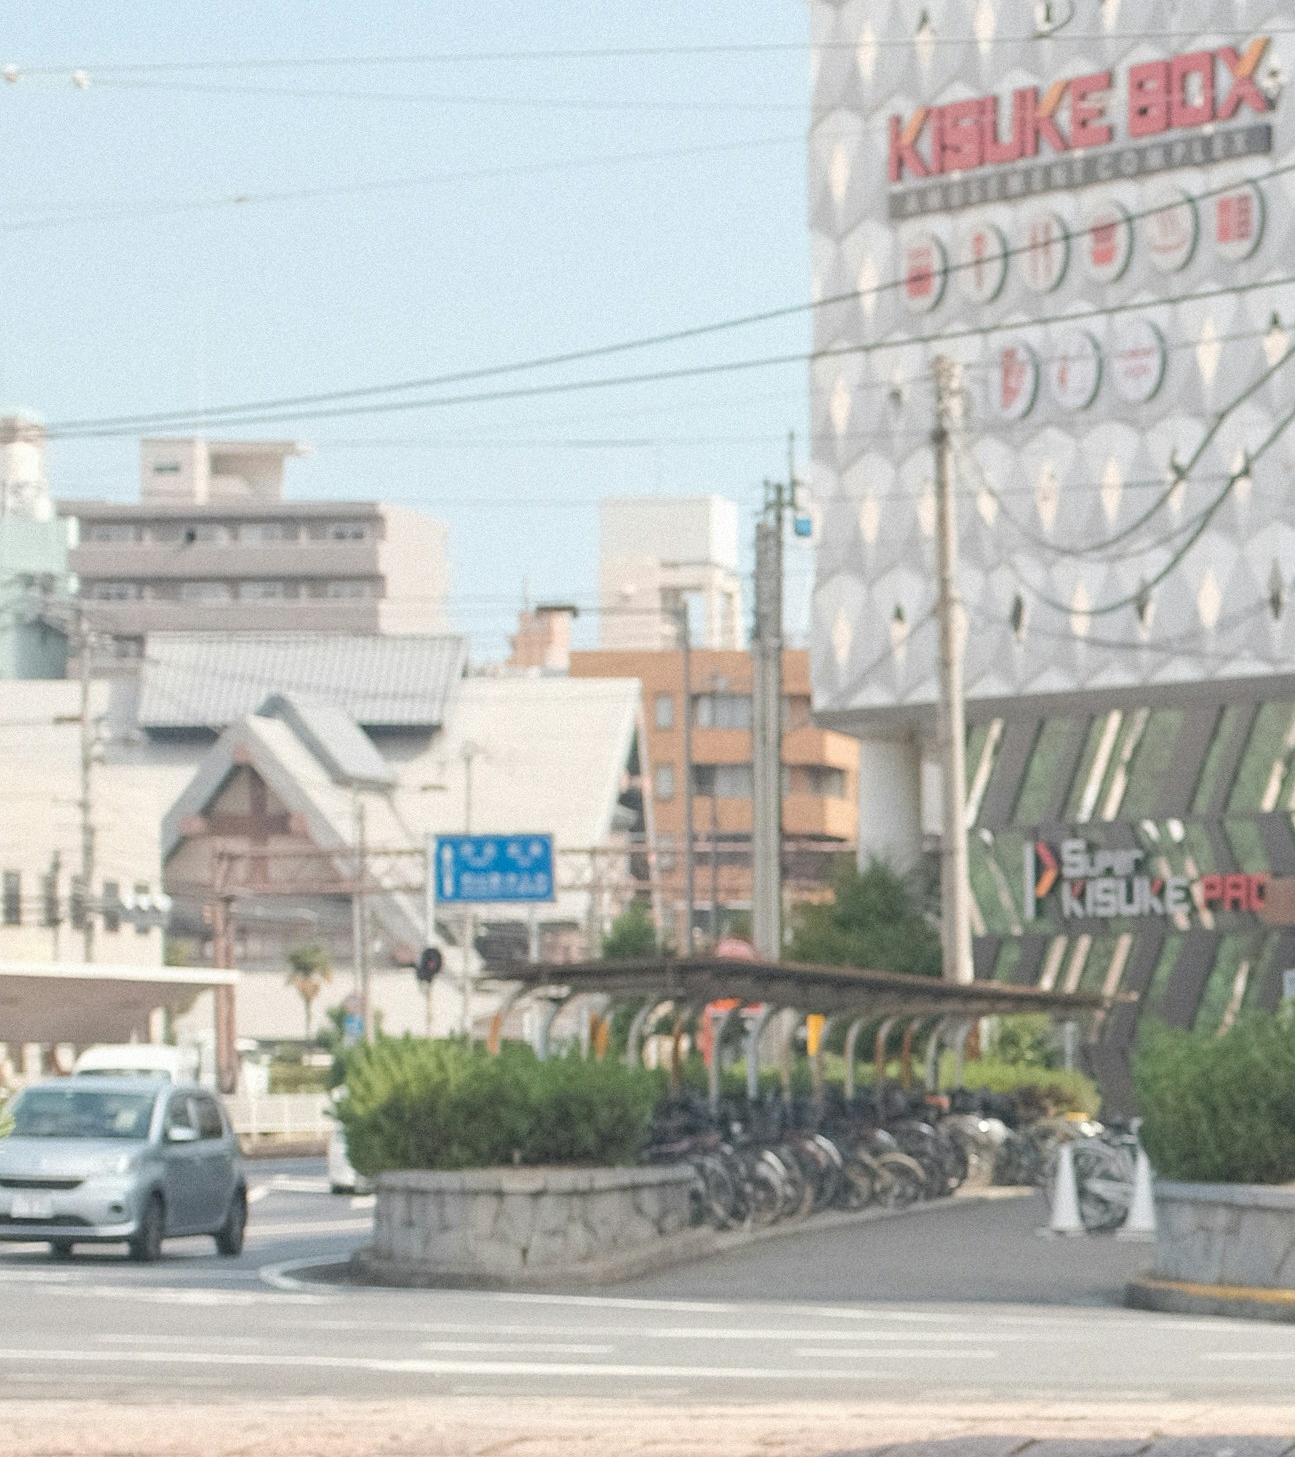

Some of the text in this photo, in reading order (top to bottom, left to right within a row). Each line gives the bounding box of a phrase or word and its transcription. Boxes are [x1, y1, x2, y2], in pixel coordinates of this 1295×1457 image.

[888, 36, 1271, 183] KISUKE BOX
[1061, 877, 1190, 919] KISUKE
